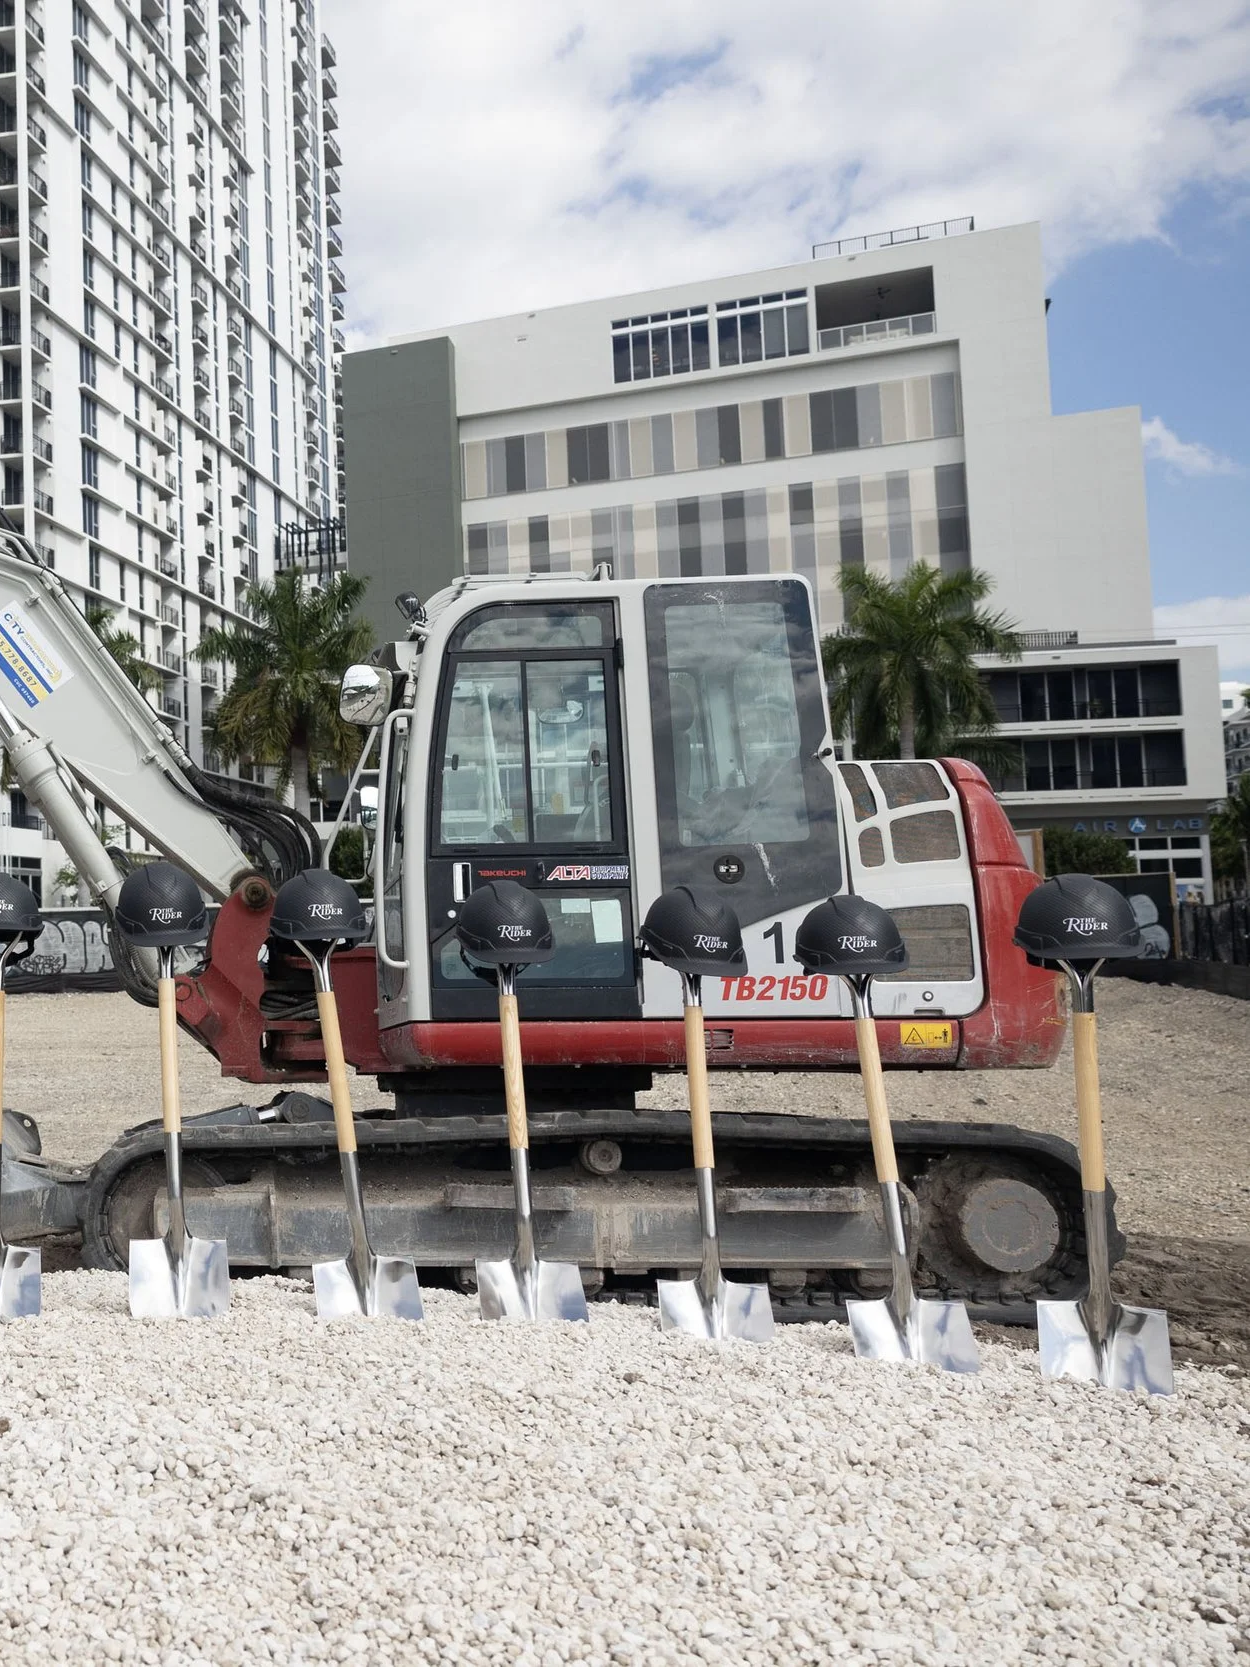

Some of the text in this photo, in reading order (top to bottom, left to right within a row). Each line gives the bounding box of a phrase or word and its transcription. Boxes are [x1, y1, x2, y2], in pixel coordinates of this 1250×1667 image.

[1073, 821, 1118, 832] AIR
[1157, 818, 1203, 831] LAB
[547, 865, 629, 881] ALTA EQUIPMENT
[149, 907, 182, 925] RIDER
[308, 903, 343, 920] RIDER
[497, 924, 532, 941] RIDER
[1062, 917, 1108, 936] RIDER
[693, 934, 728, 953] RIDER
[837, 935, 877, 953] RIDER
[720, 974, 829, 1001] TB2150
